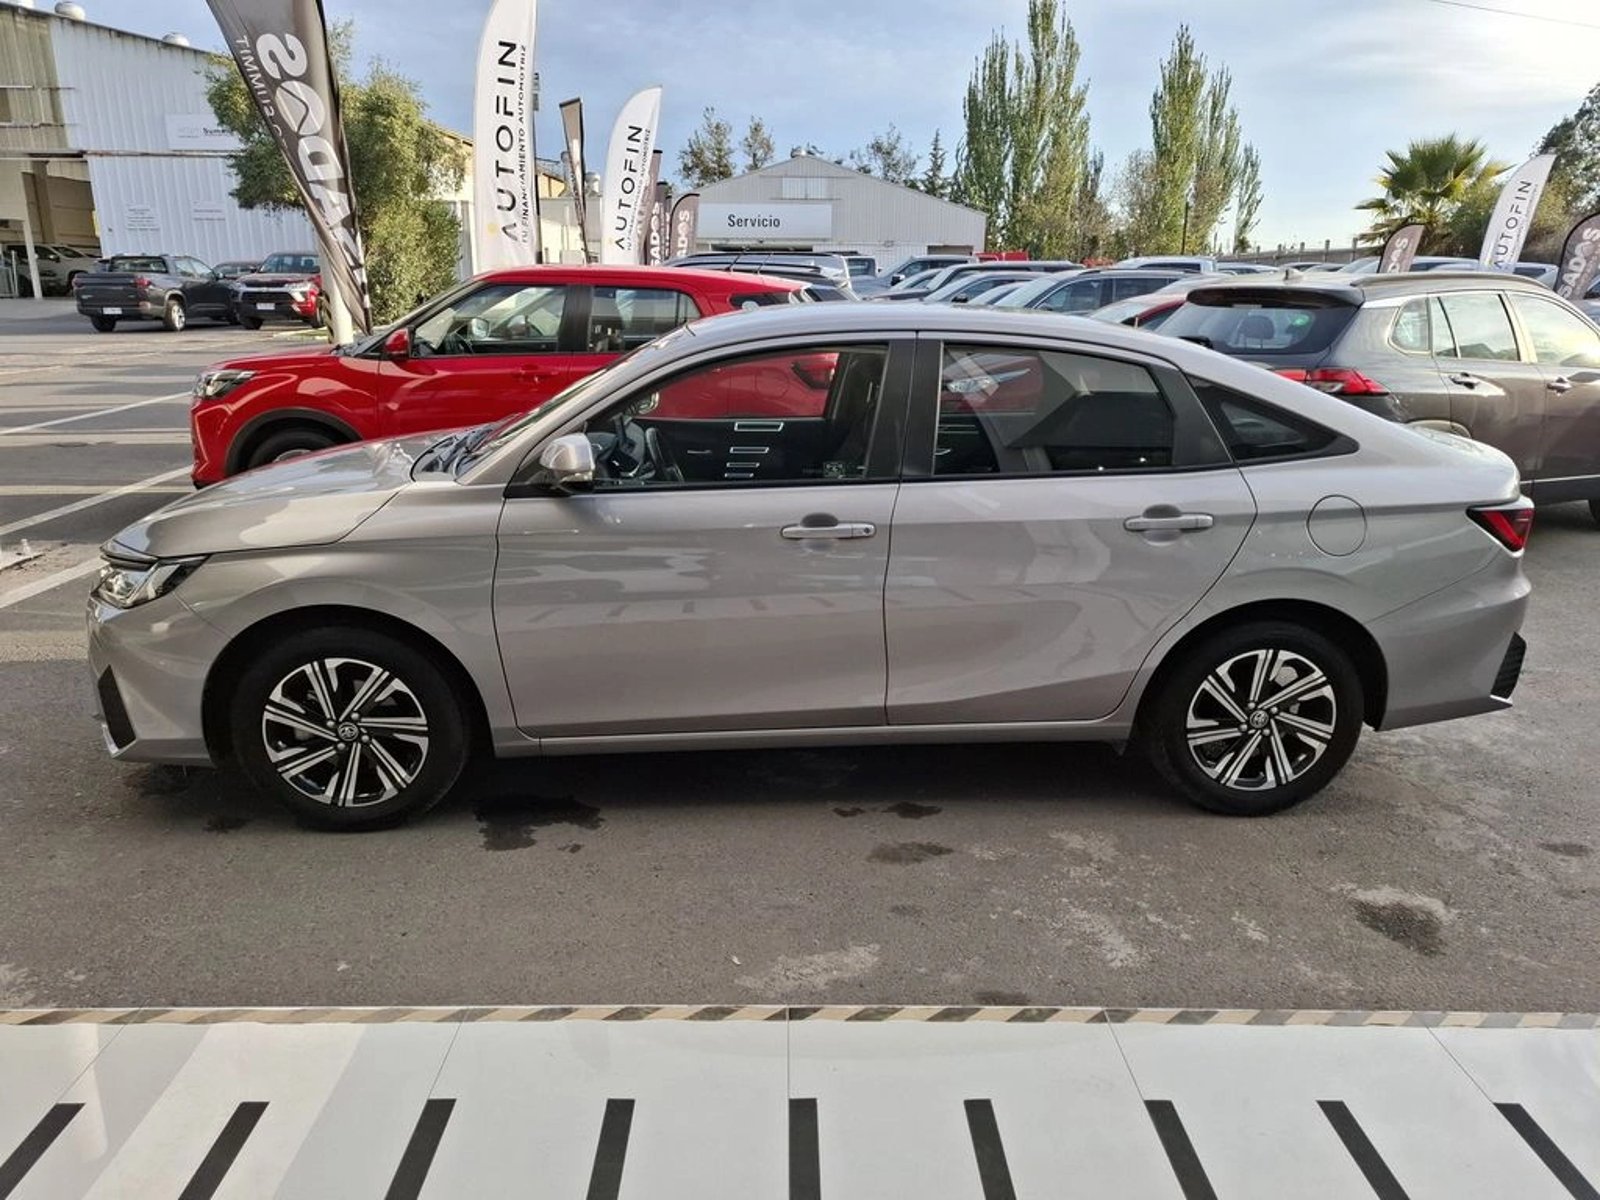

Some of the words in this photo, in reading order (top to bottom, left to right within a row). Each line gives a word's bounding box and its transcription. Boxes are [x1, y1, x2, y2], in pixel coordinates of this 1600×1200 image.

[518, 45, 526, 124] AUTOMOTRIZ
[495, 41, 518, 241] AUTOFIN
[615, 125, 642, 250] AUTOFIN
[728, 213, 781, 228] Servicio
[1494, 180, 1532, 269] AUTOFIN
